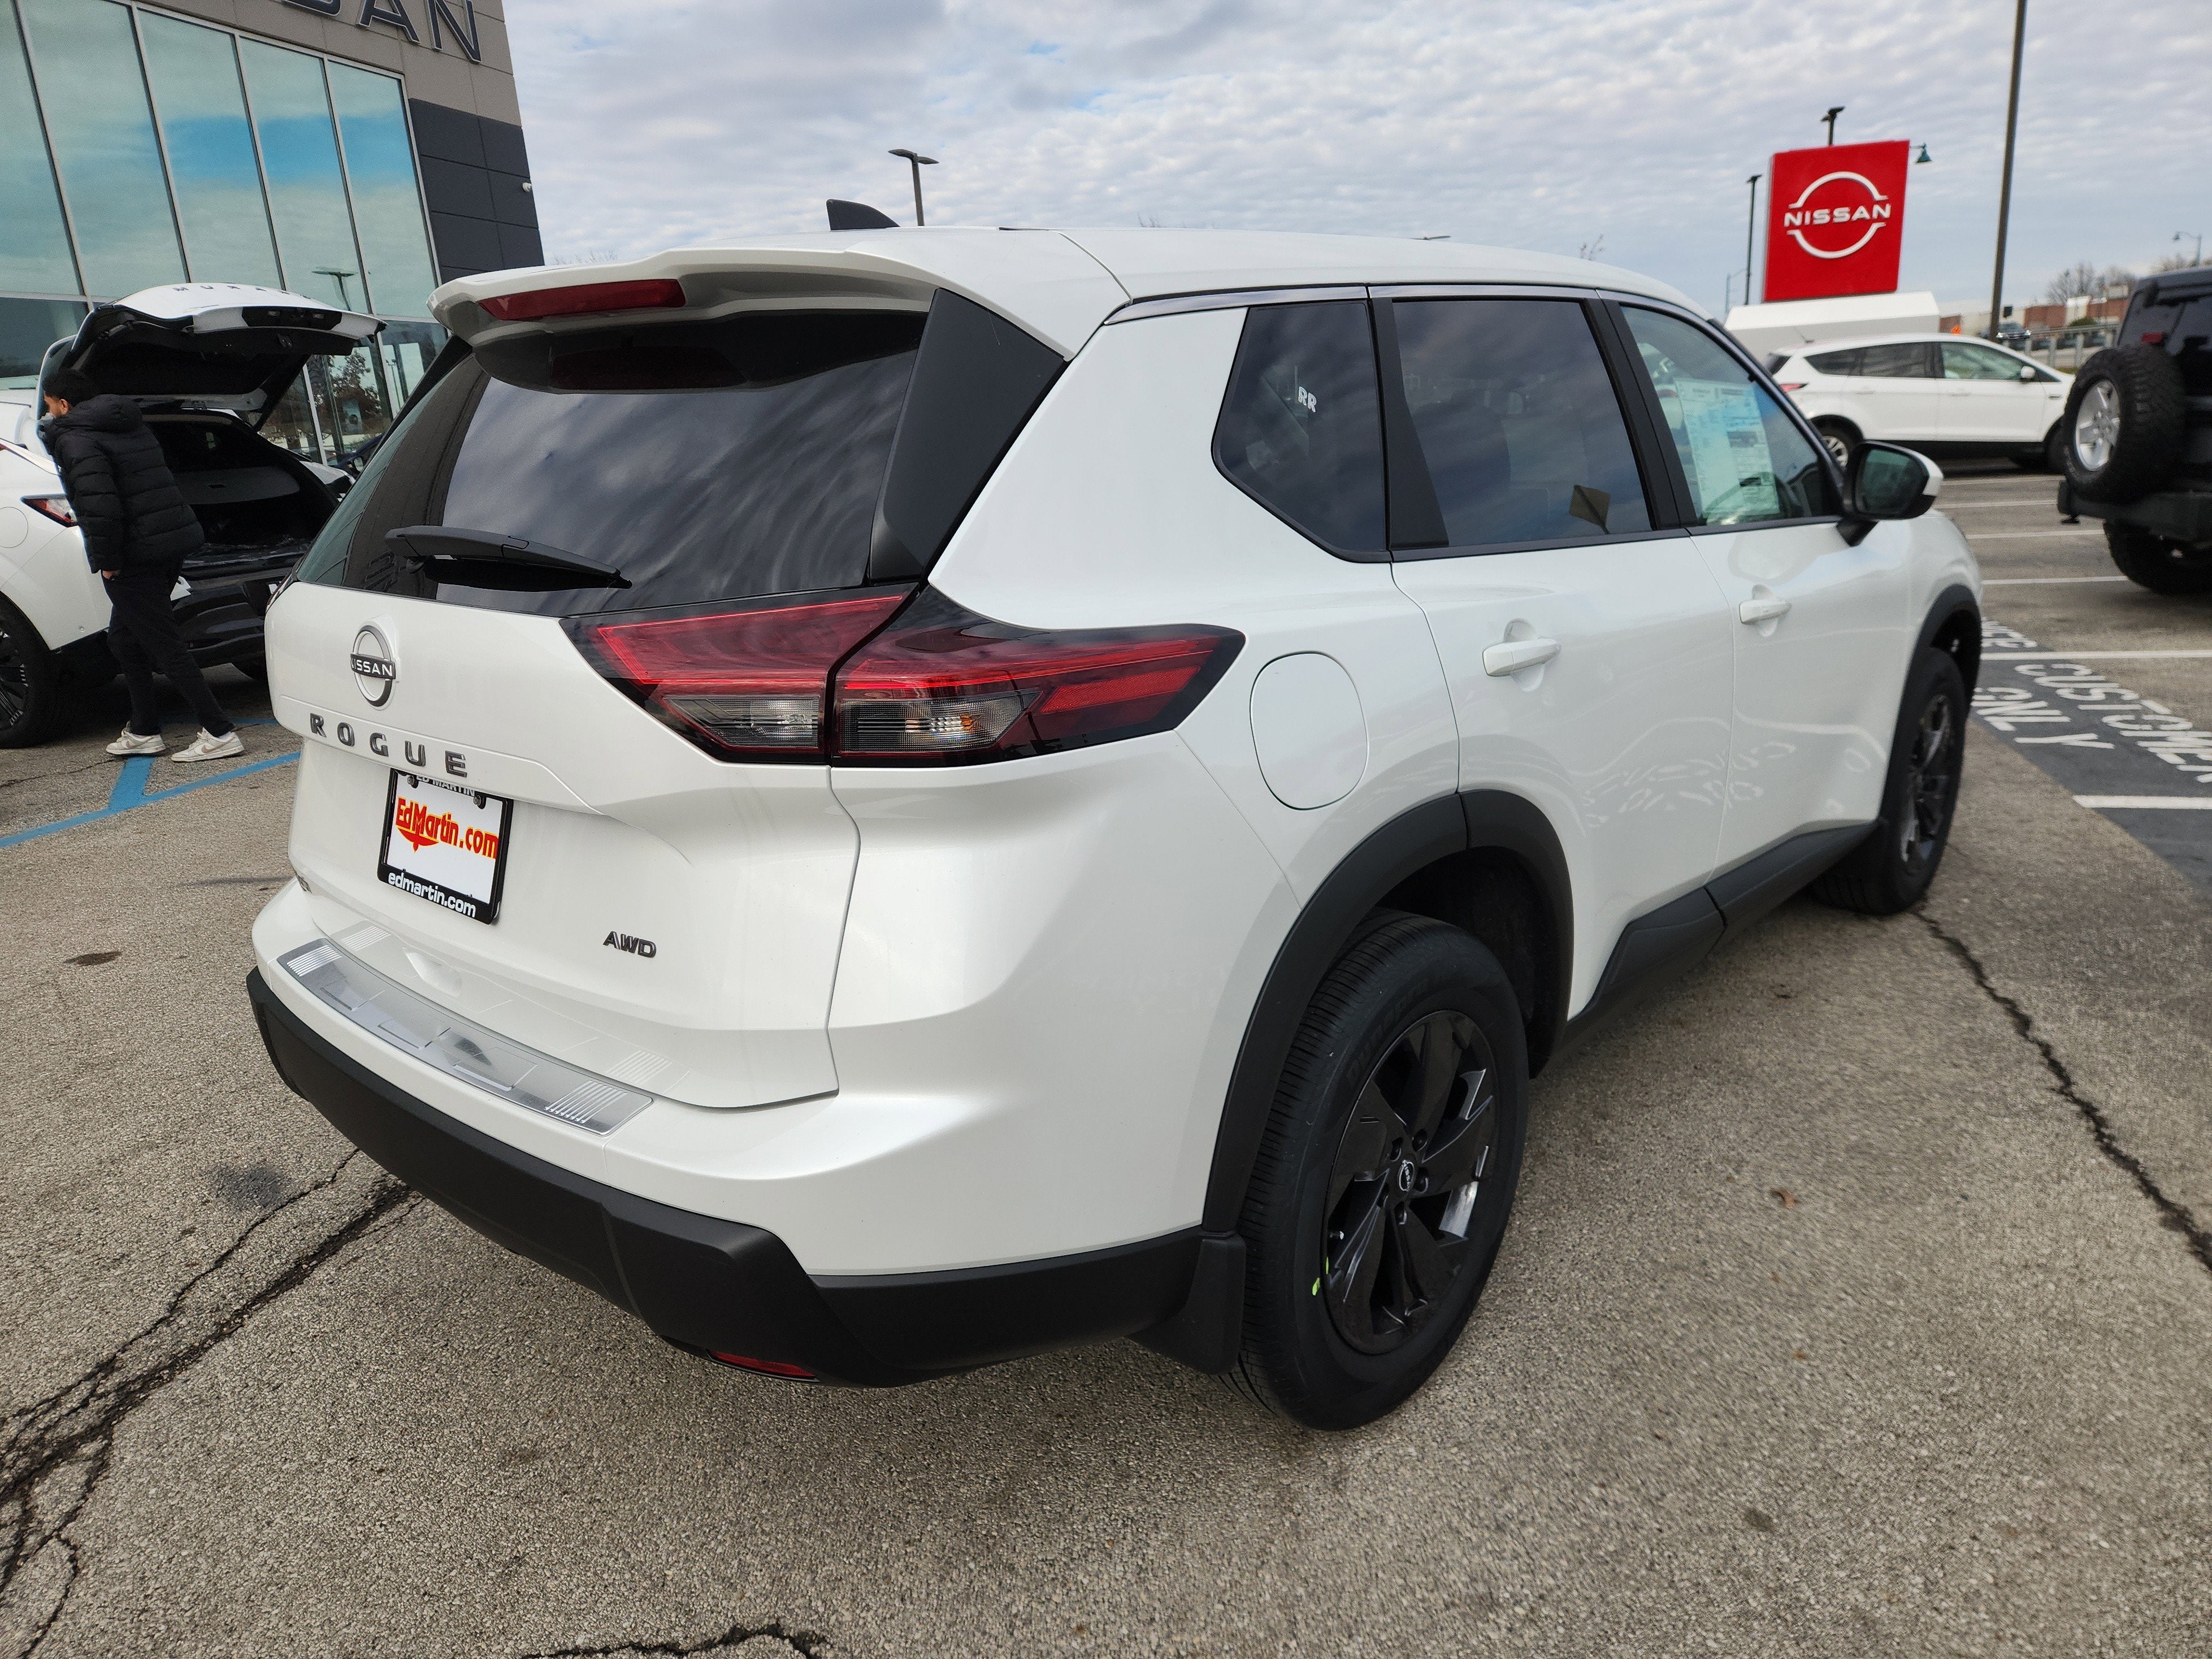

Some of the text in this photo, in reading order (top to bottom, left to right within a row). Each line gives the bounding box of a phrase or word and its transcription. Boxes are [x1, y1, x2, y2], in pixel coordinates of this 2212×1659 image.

[1783, 203, 1892, 228] NISSAN
[1298, 386, 1317, 413] RR
[351, 657, 394, 677] NISSAN
[310, 712, 468, 778] ROGUE
[395, 796, 499, 859] EdMartin.com
[388, 871, 477, 918] edmartin.com
[602, 930, 657, 959] AWD
